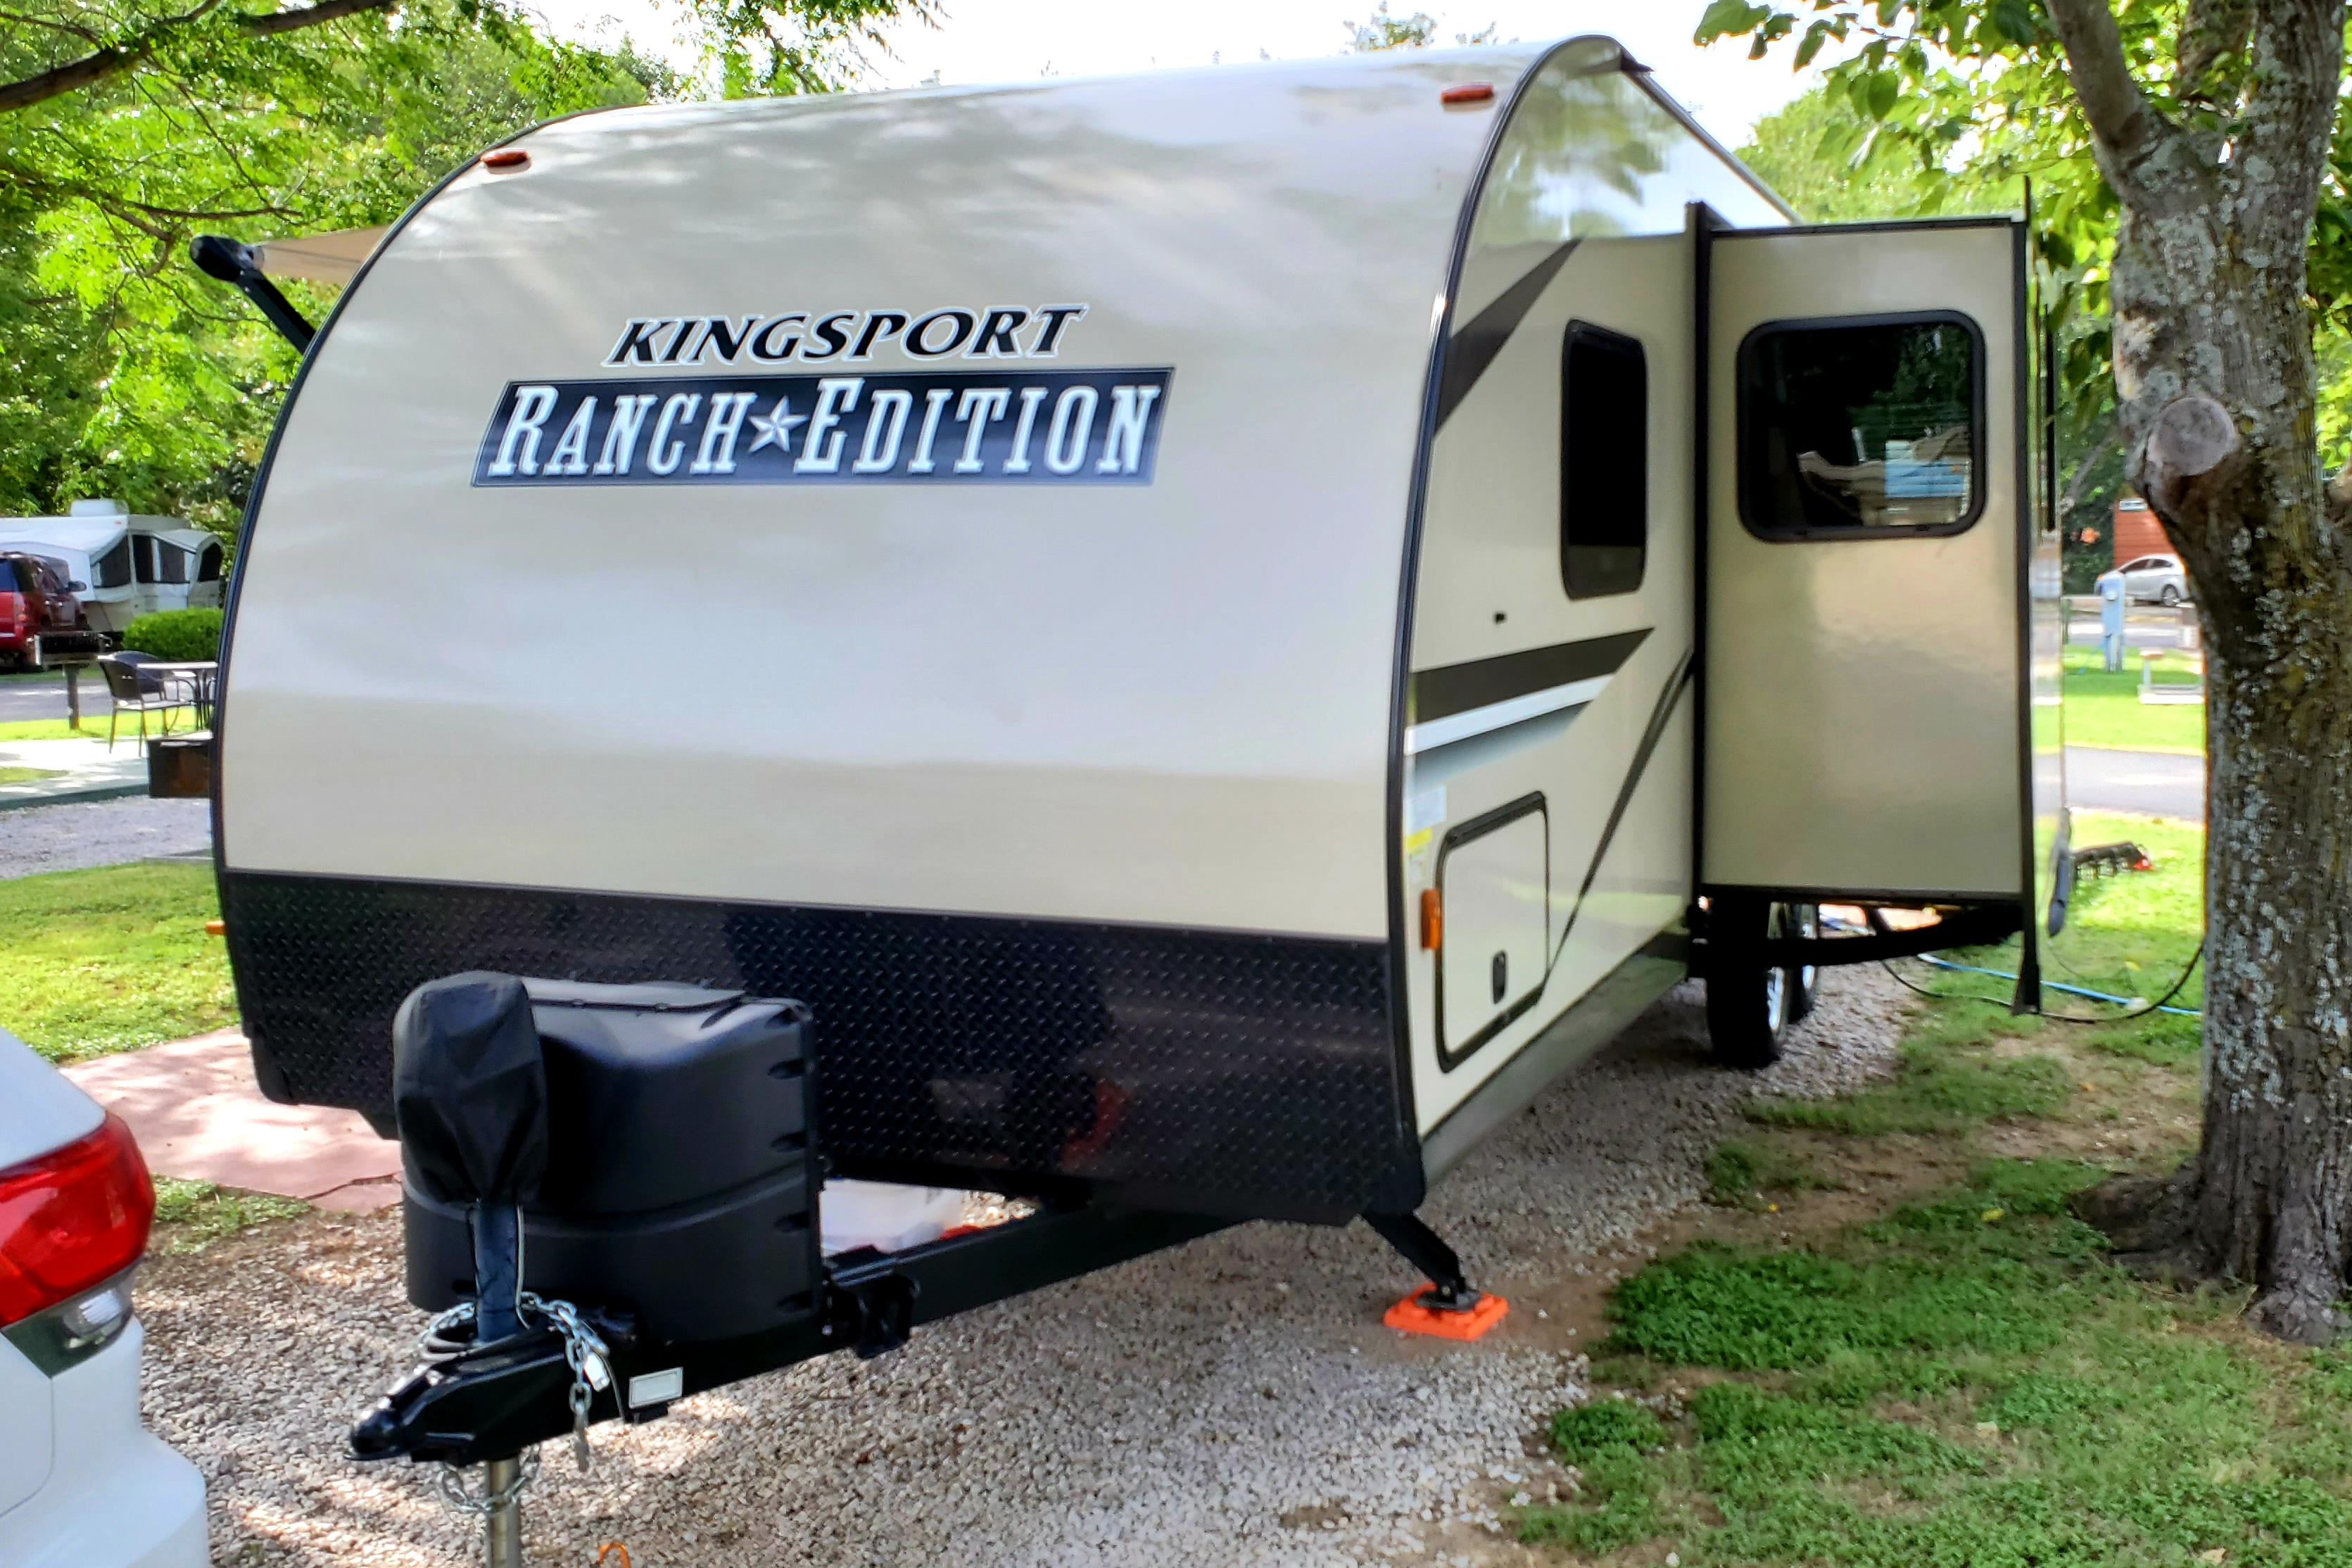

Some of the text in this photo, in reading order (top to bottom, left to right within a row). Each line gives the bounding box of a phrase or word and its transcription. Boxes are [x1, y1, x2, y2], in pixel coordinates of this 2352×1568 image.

[602, 303, 1090, 366] KINGSPORT
[488, 377, 1161, 476] RANCH EDITION
